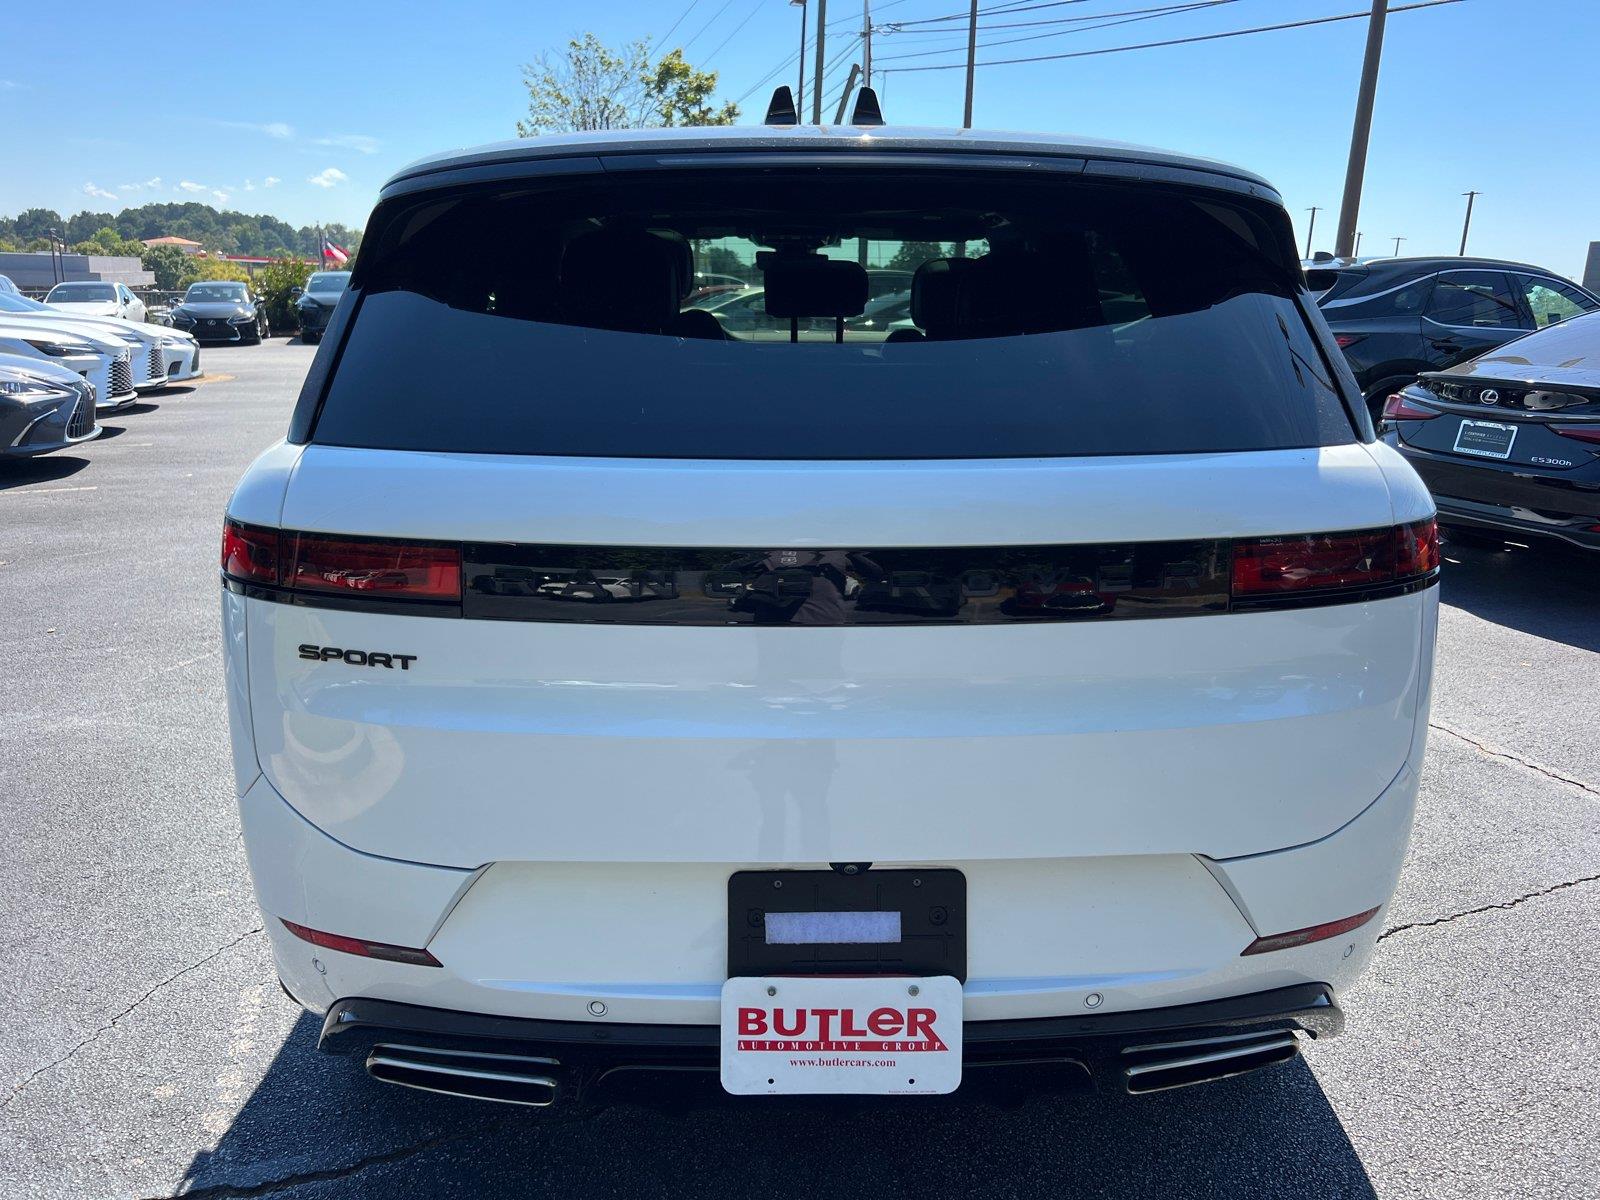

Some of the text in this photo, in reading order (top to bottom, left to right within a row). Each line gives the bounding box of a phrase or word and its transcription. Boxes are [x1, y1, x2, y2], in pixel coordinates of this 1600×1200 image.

[1531, 456, 1572, 466] ES300h
[298, 643, 418, 670] SPORT
[739, 1041, 942, 1051] AUTOMOTIVE GROUP
[790, 1057, 896, 1068] www.butlercars.com
